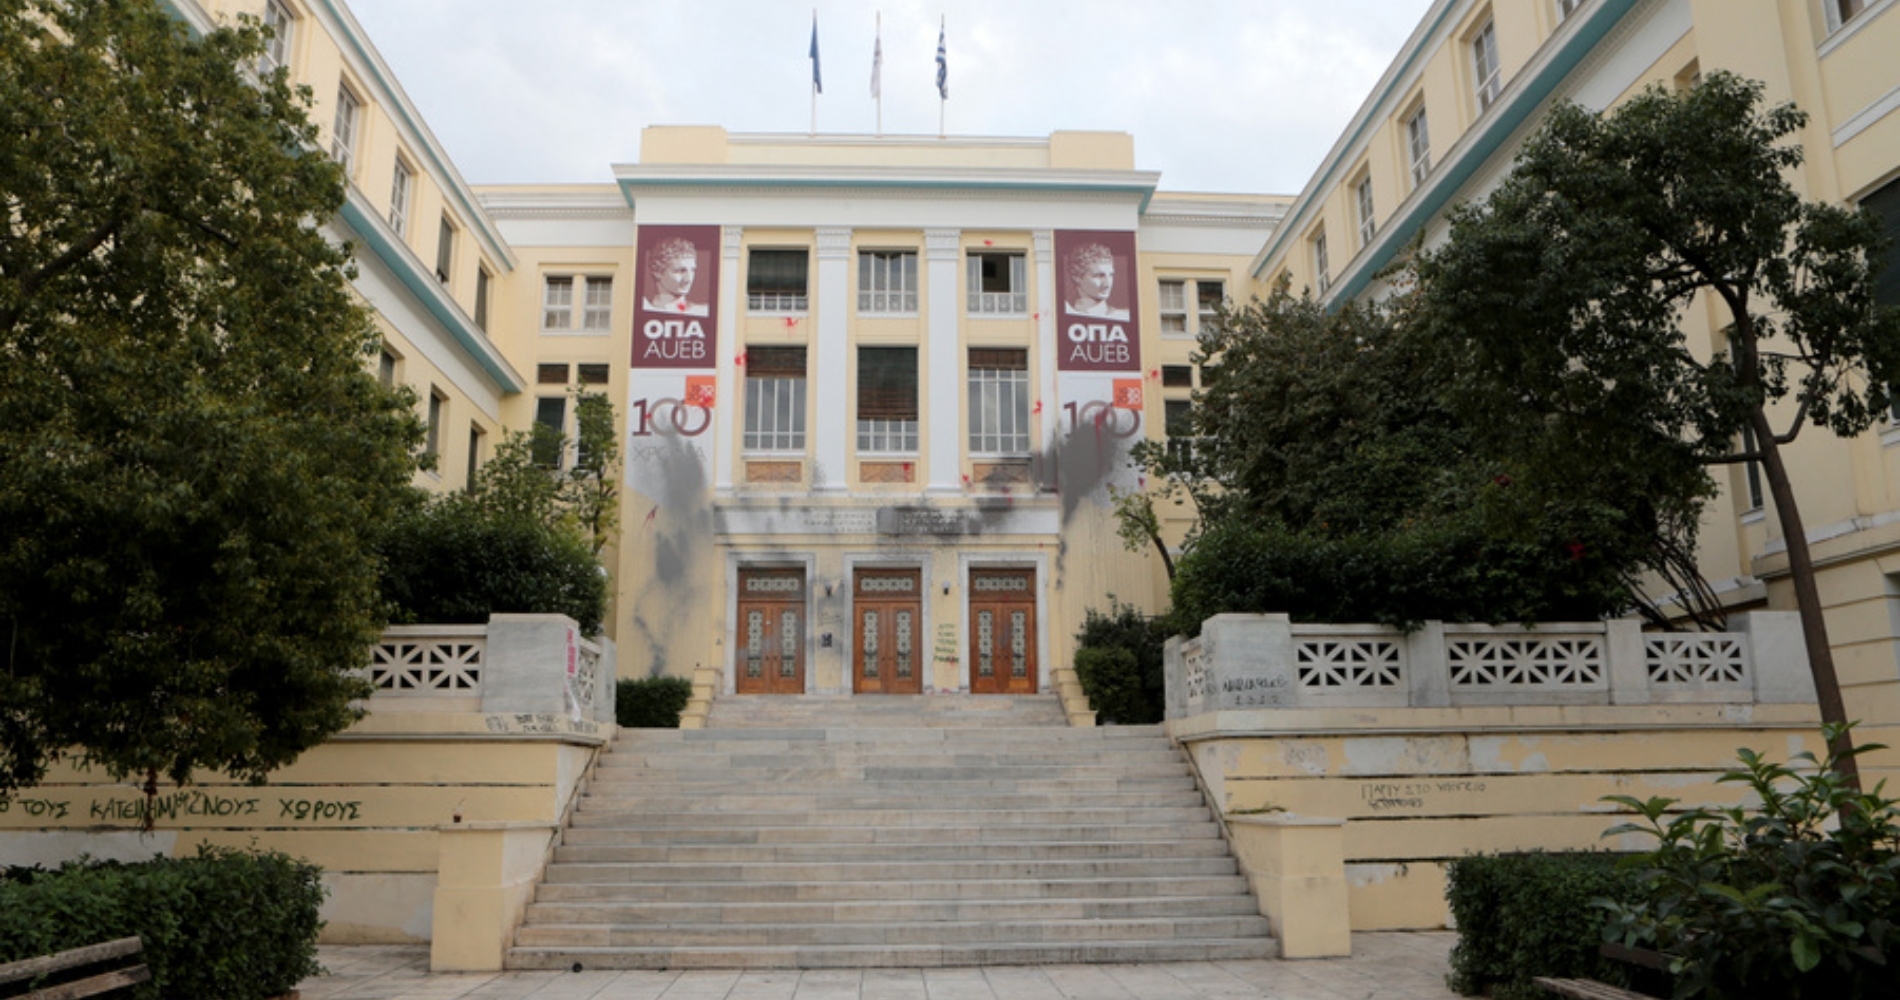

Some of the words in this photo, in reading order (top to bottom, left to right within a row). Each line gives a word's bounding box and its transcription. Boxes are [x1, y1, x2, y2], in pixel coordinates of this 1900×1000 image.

[643, 319, 706, 339] ΟΠΑ
[1067, 323, 1129, 342] ΟΠΑ
[643, 340, 706, 359] AUEB
[1070, 344, 1130, 363] AUEB
[632, 397, 711, 437] 100
[17, 798, 71, 820] ΤΟΥΣ
[279, 799, 362, 821] ΧΩΡΟΥΣ
